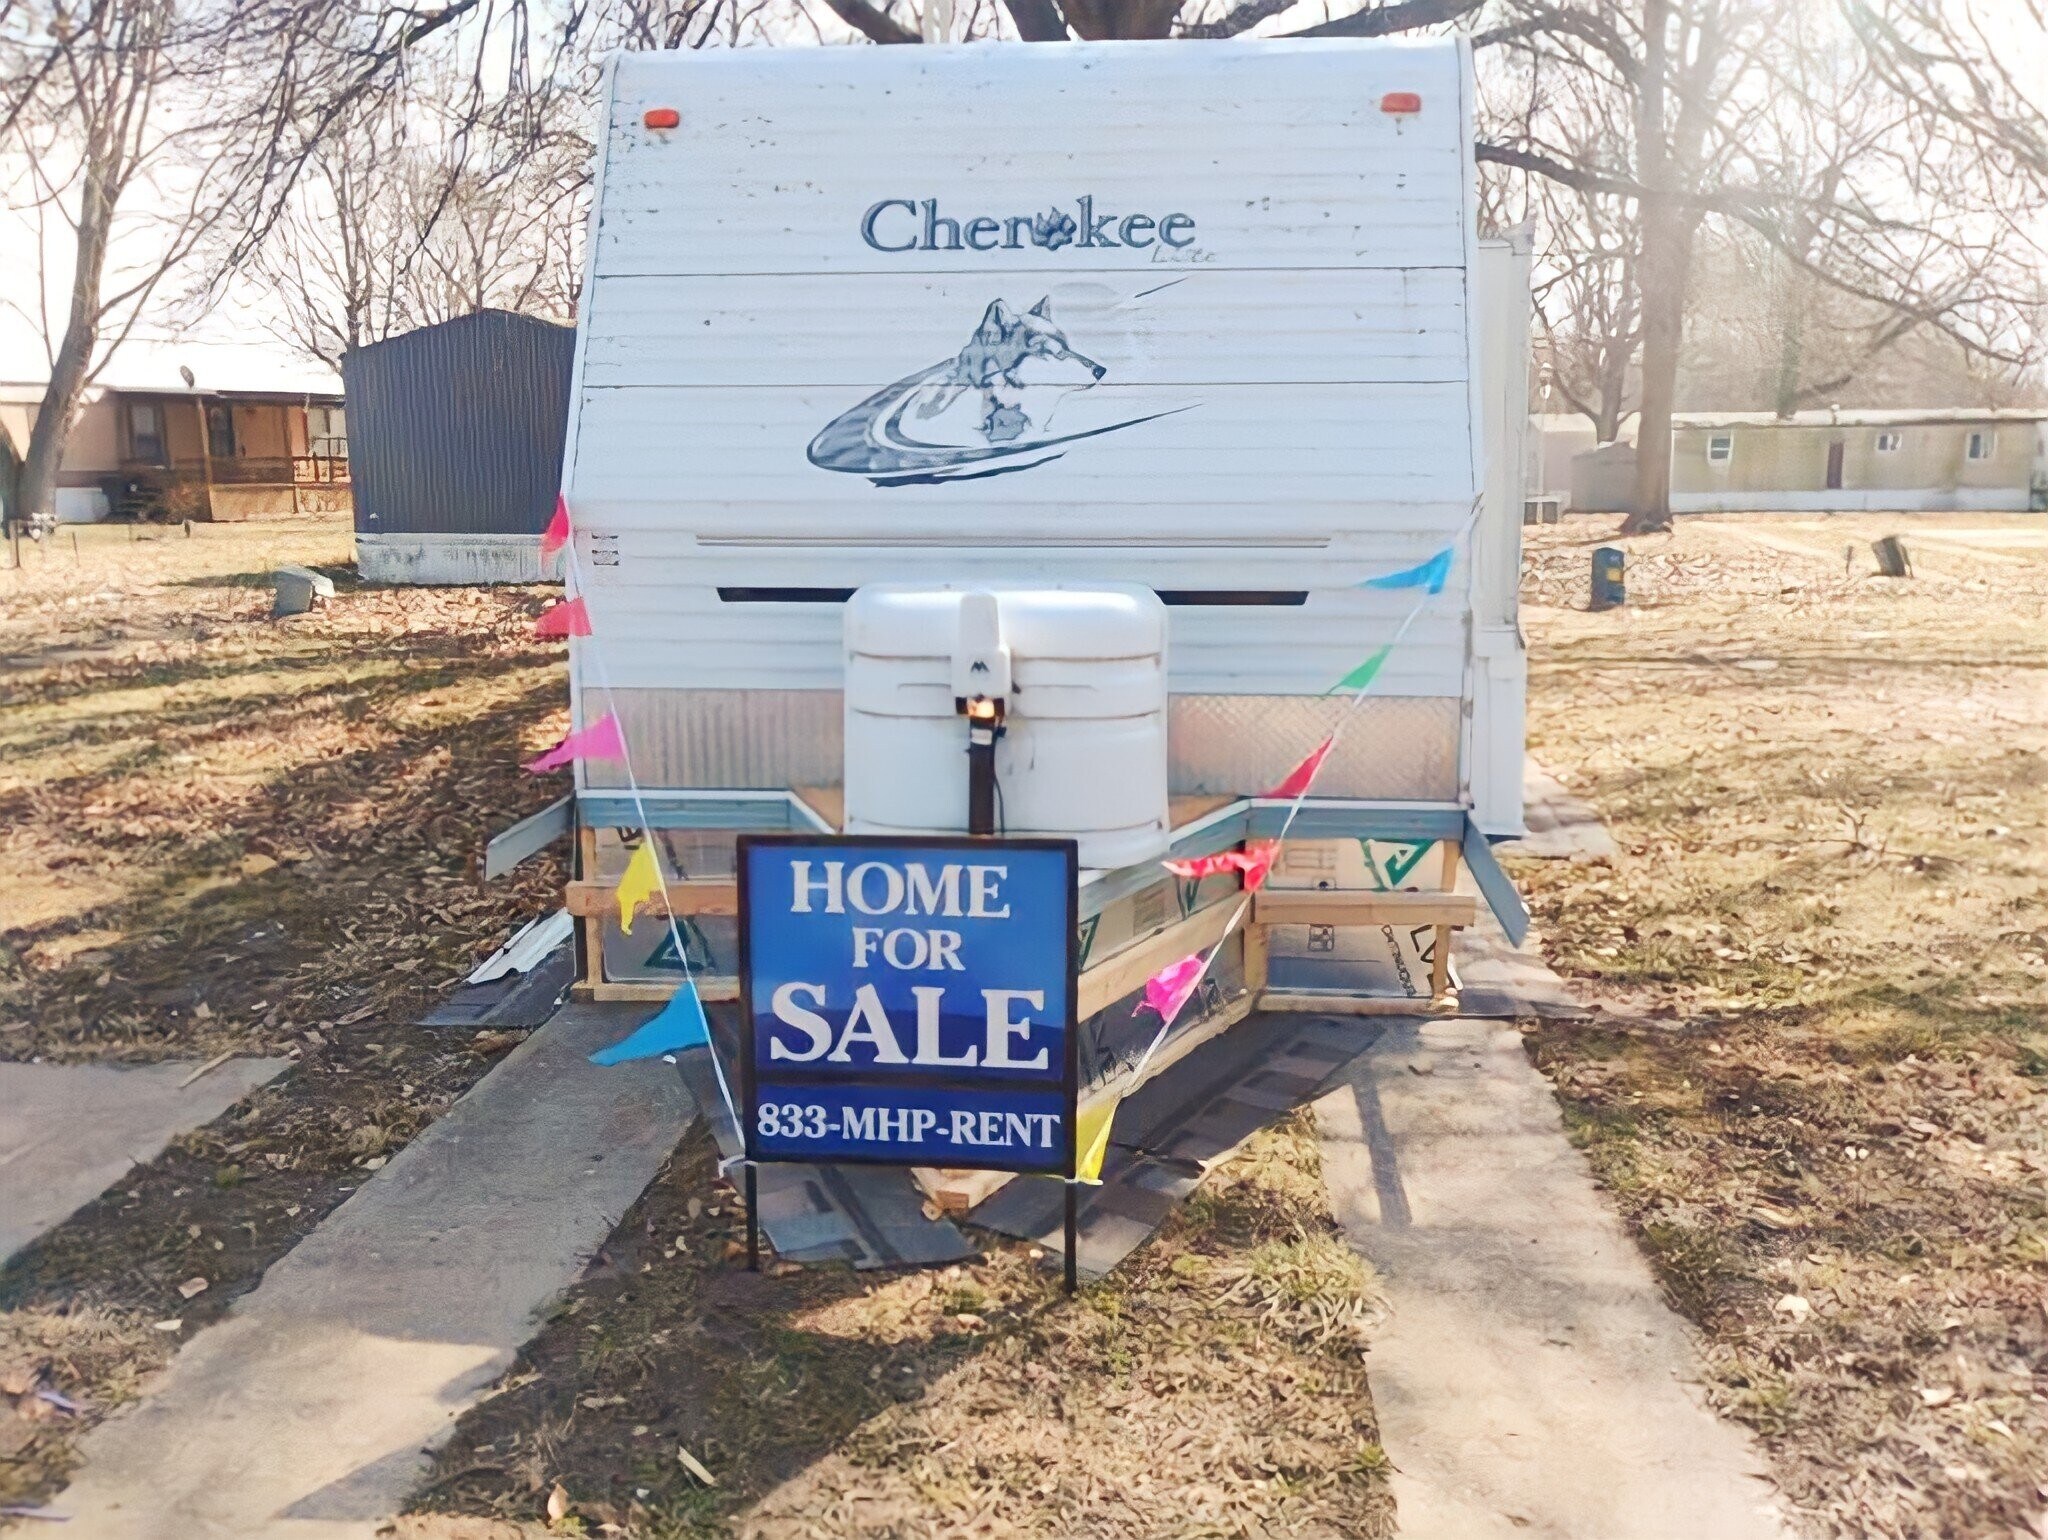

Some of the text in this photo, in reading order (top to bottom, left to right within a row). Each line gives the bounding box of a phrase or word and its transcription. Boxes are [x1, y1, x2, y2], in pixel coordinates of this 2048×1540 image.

[790, 860, 1010, 918] HOME
[852, 926, 967, 971] FOR
[770, 981, 1049, 1070] SALE
[757, 1102, 1061, 1148] 833-MHP-RENT
